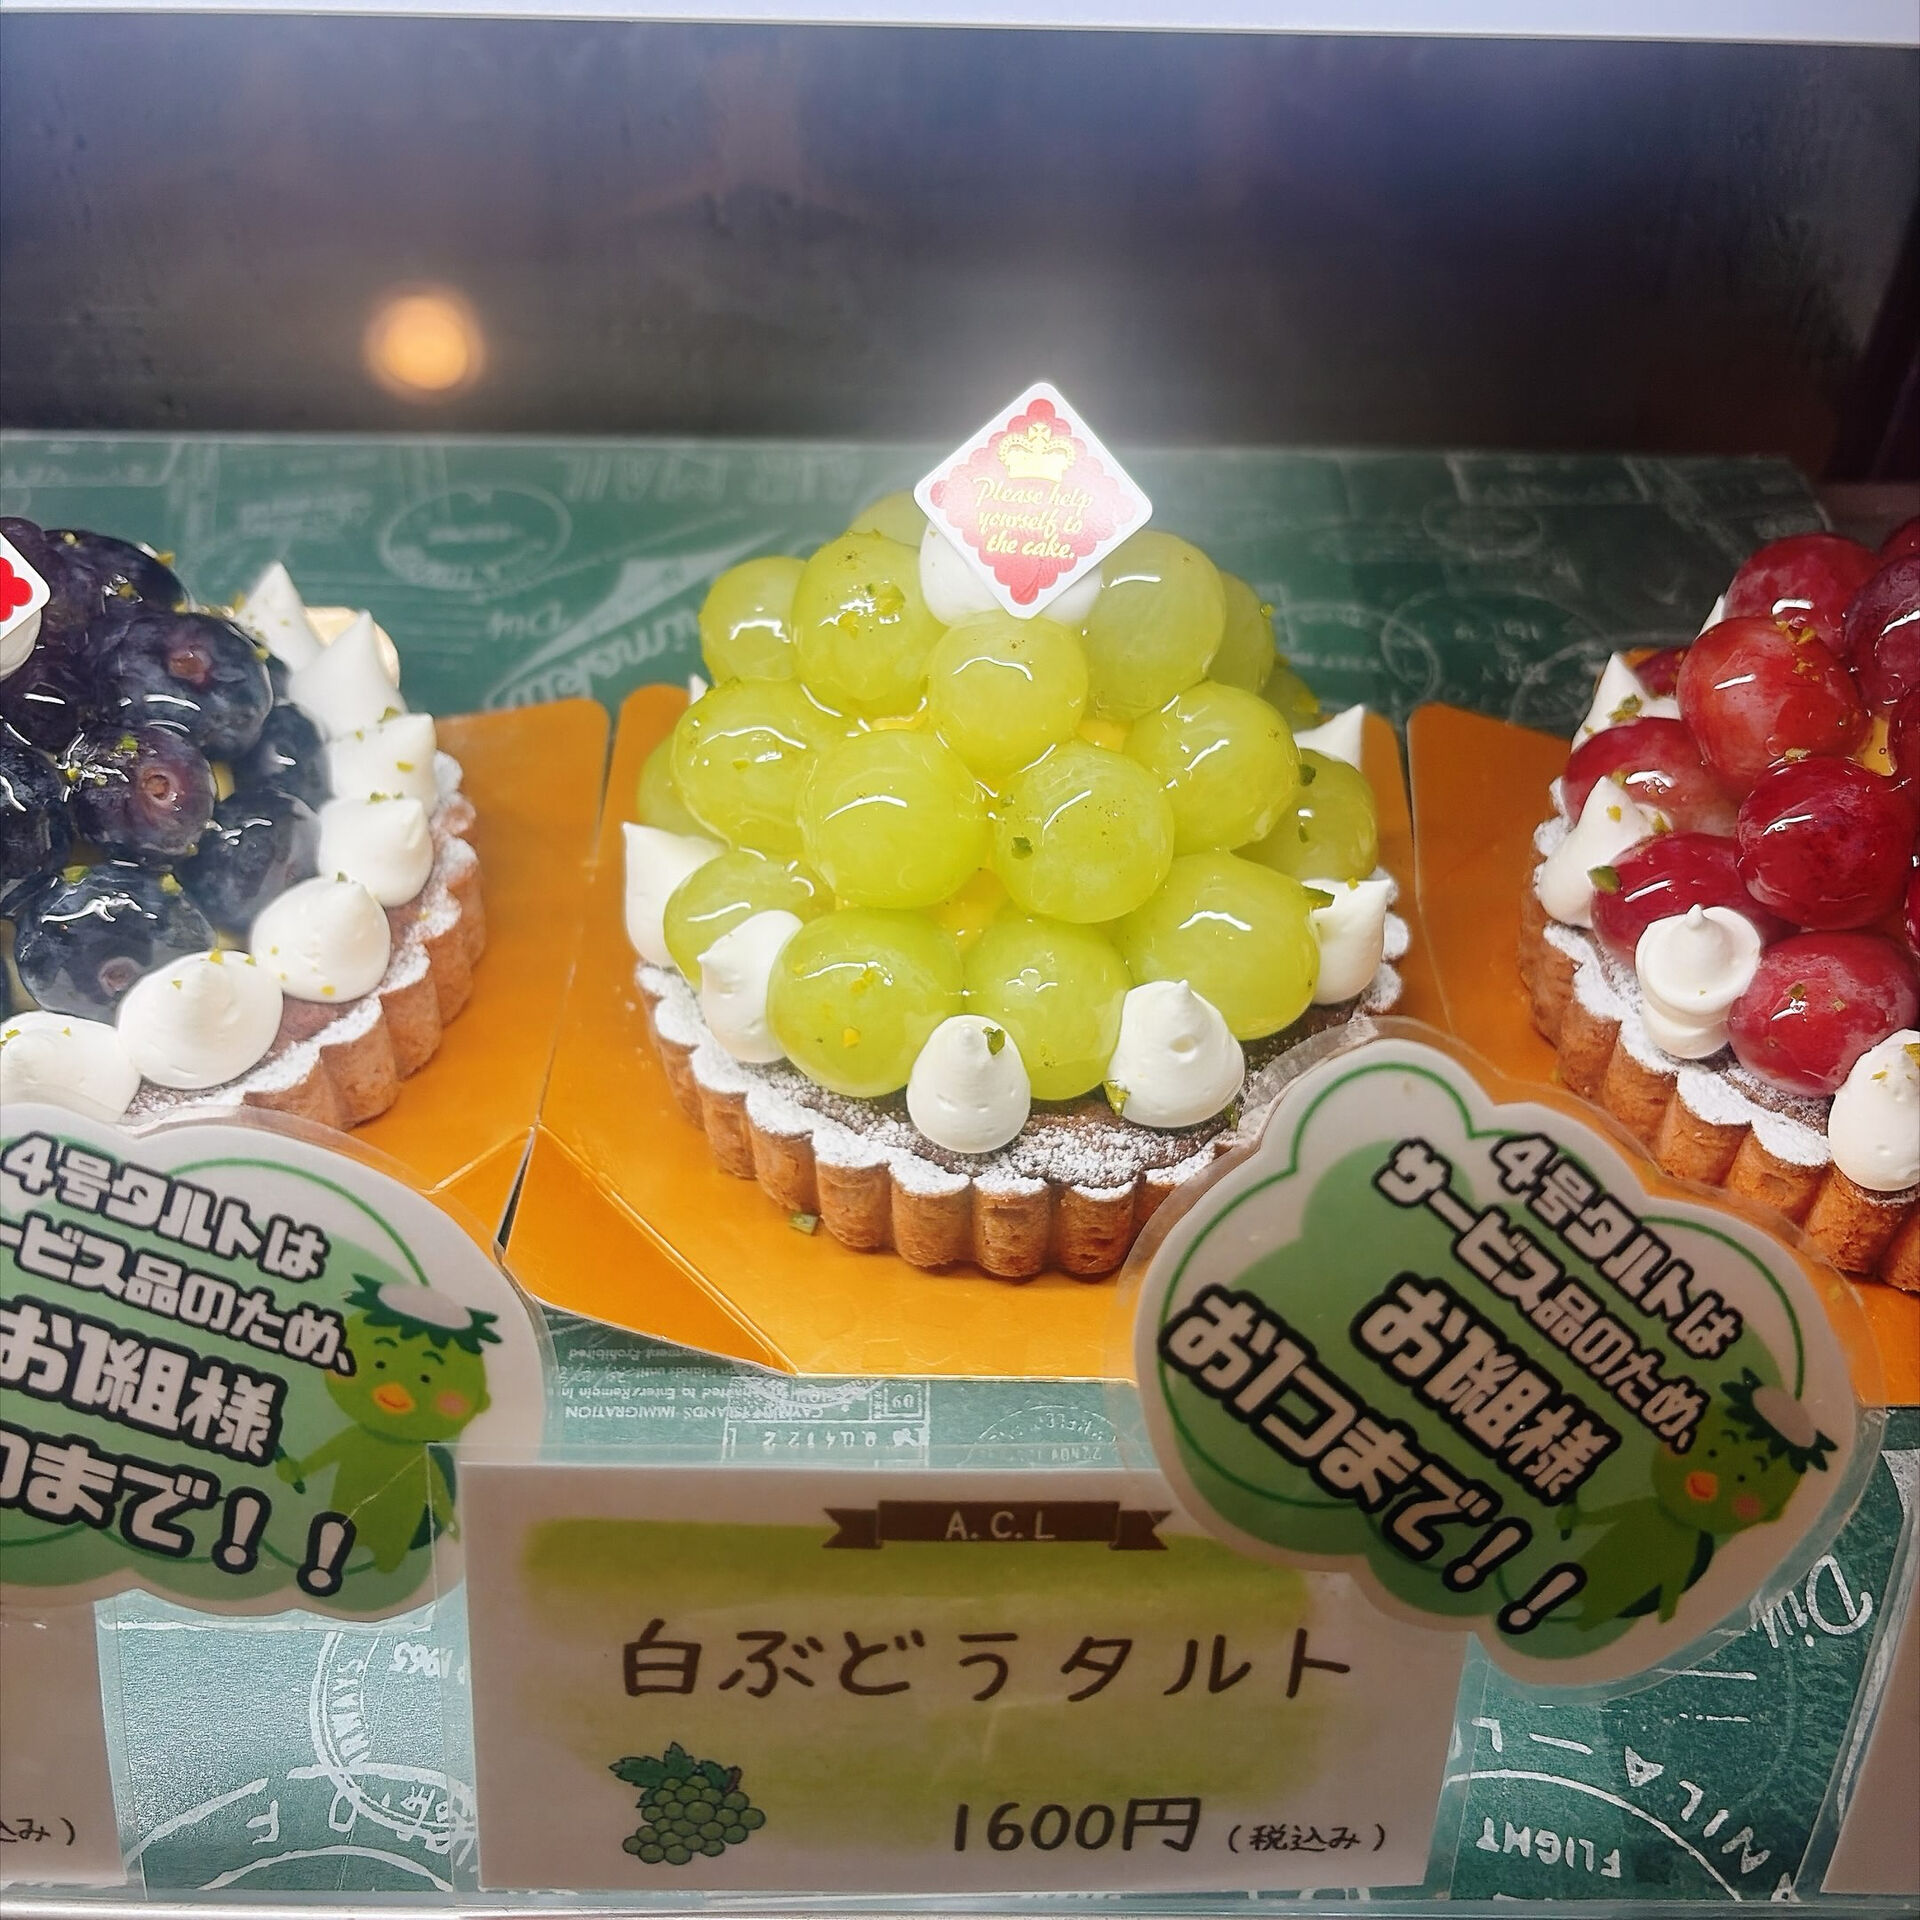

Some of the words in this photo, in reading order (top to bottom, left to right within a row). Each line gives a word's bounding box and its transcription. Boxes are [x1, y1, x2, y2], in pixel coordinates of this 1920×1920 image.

[972, 477, 1042, 507] Please
[1049, 485, 1092, 514] help
[977, 511, 1057, 539] yourself
[1064, 516, 1083, 534] to
[987, 534, 1016, 554] the
[2, 1131, 329, 1284] 4号タルトは
[1489, 1132, 1745, 1362] 4号タルトは
[1374, 1136, 1711, 1454] サービス品のため、
[565, 1405, 676, 1419] IMMIGRATION
[1351, 1272, 1624, 1508] お1組様
[945, 1510, 1056, 1542] A.C.L
[620, 1618, 1352, 1703] 白ぶどうタルト
[952, 1796, 1202, 1854] 1600円
[1475, 1816, 1621, 1879] FLIGHT
